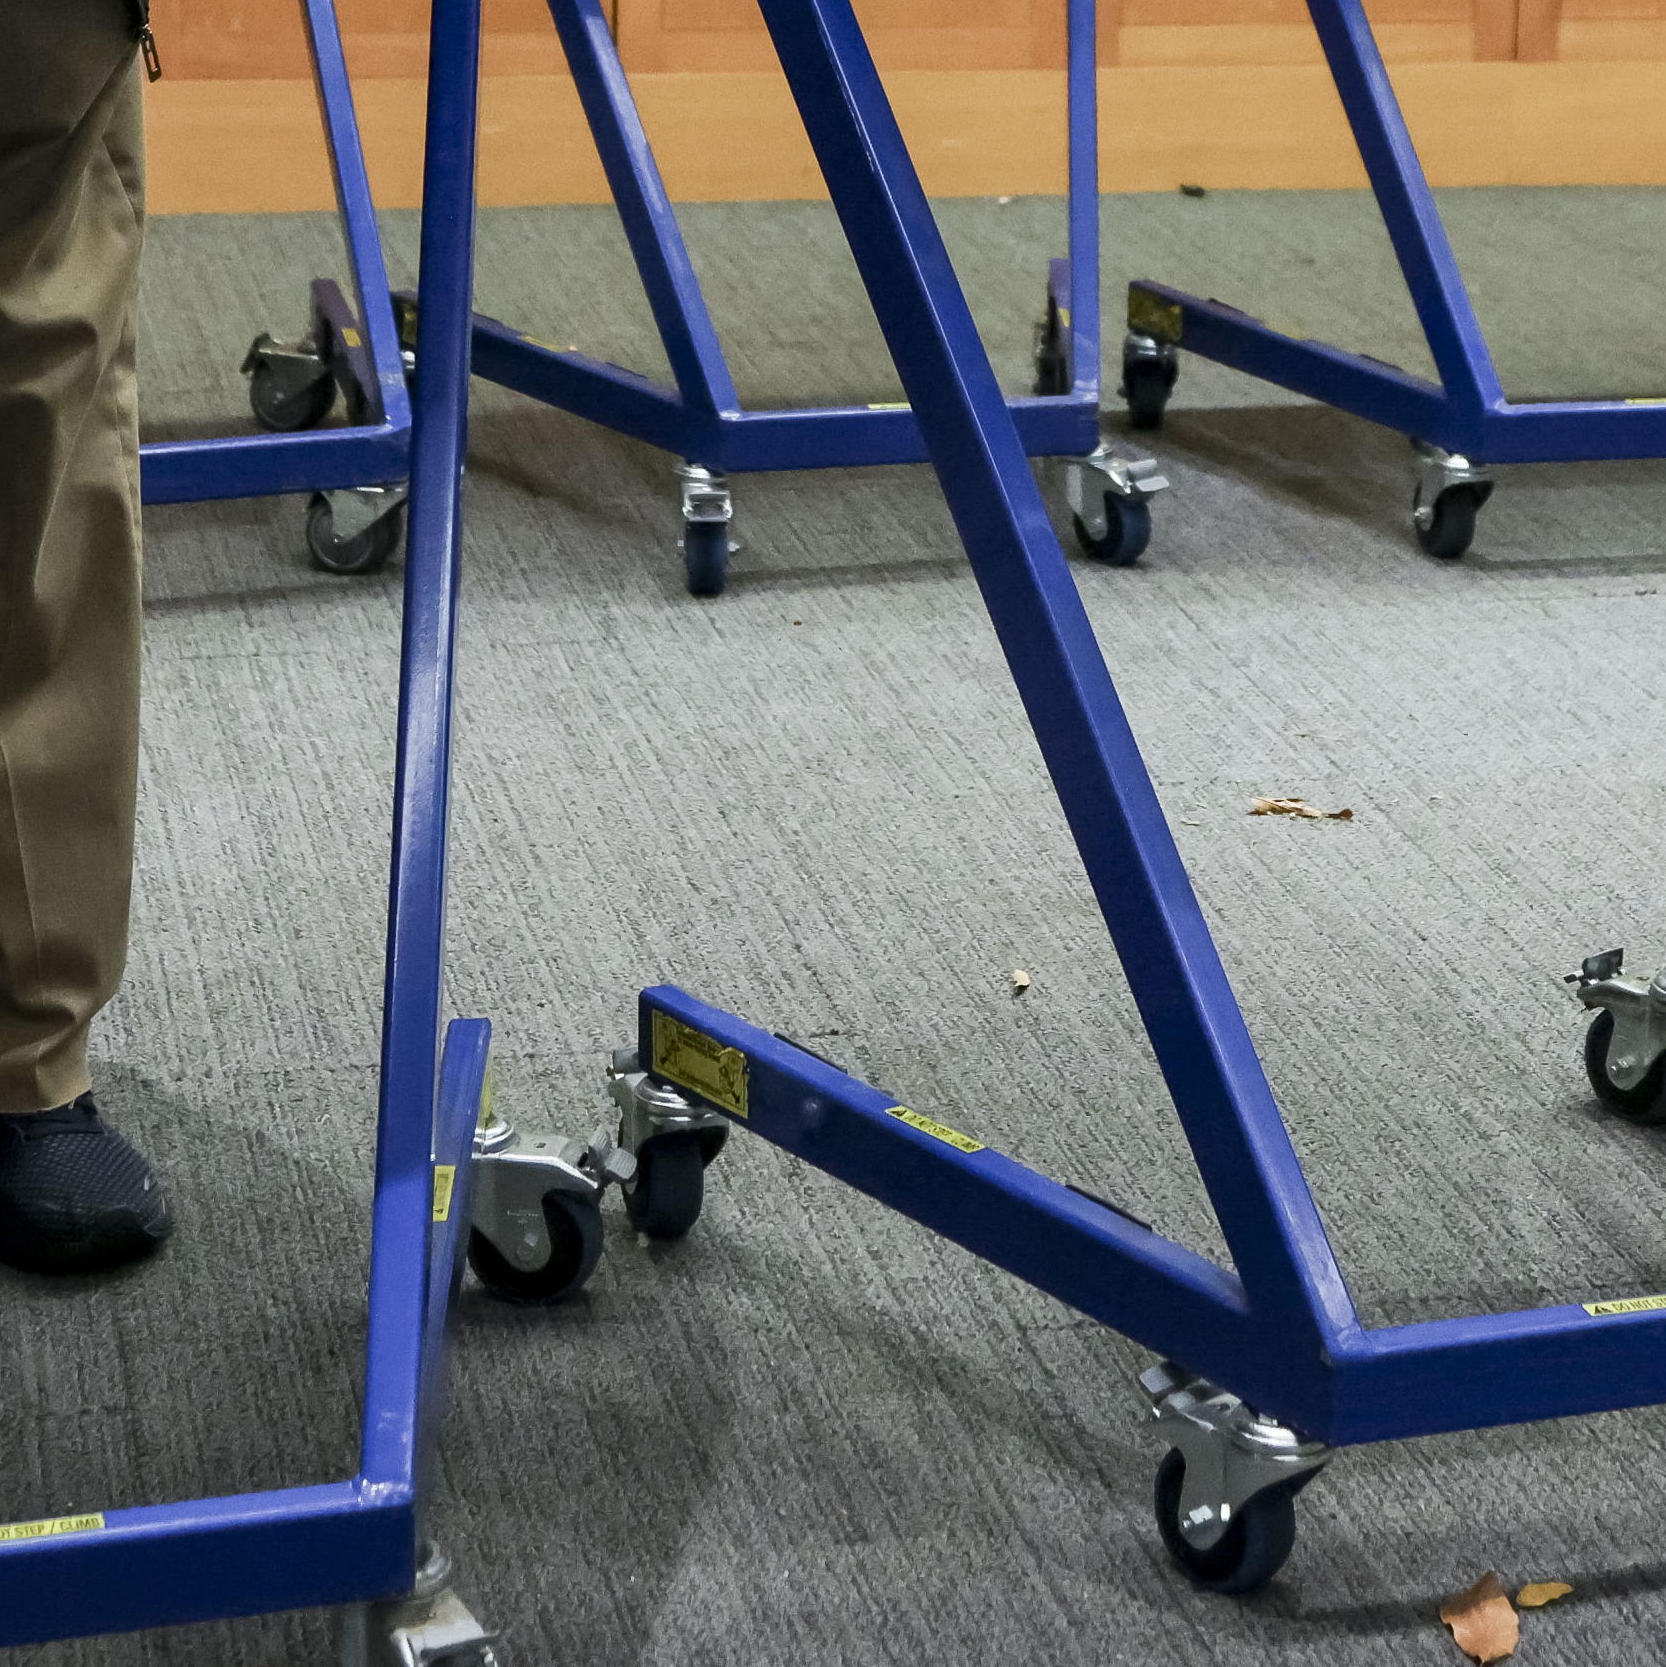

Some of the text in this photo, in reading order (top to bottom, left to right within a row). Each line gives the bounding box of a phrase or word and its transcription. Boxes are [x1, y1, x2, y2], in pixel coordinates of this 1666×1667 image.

[1611, 1302, 1630, 1312] DO
[14, 1524, 45, 1539] STEP
[60, 1517, 100, 1532] CLIMB
